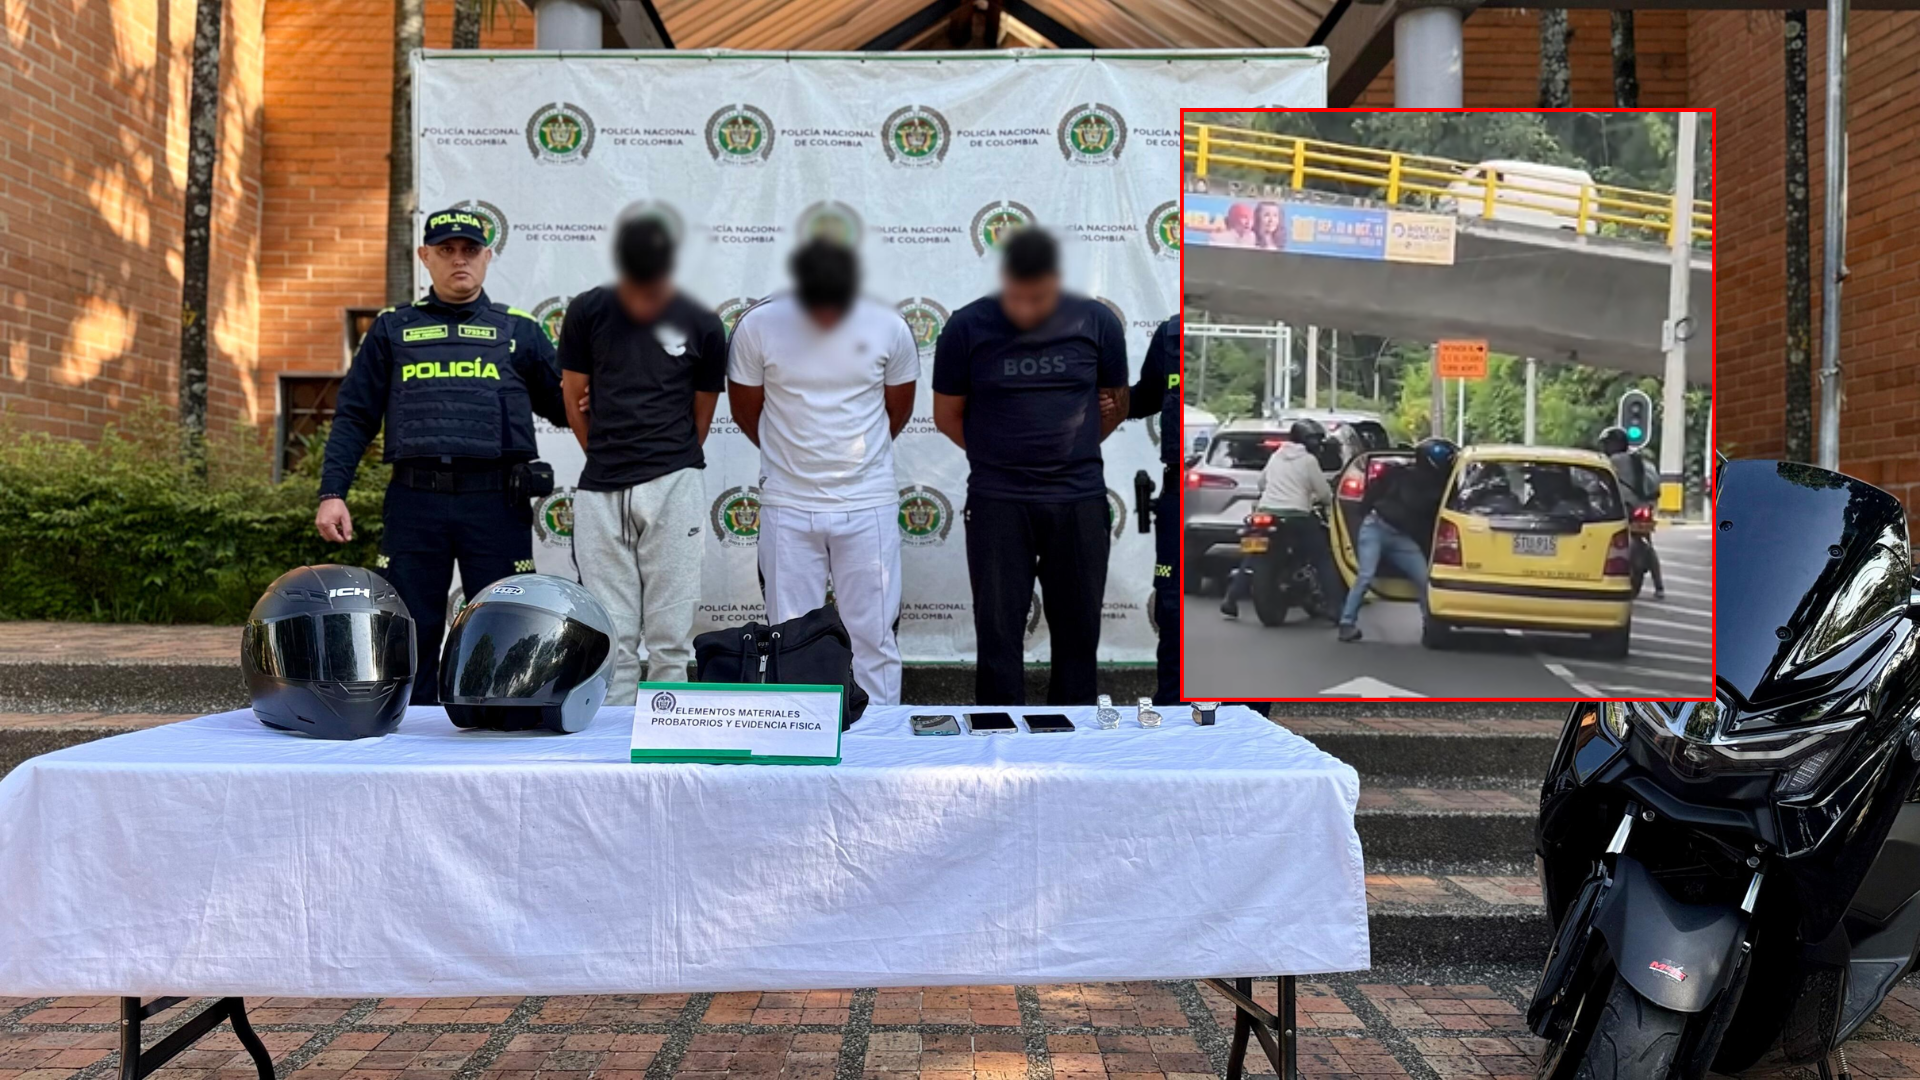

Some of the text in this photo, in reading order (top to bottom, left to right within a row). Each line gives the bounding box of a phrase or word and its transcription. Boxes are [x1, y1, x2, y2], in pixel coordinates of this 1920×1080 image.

[423, 126, 520, 136] POLICÍA NACIONAL
[600, 126, 697, 136] POLICÍA NACIONAL
[780, 127, 876, 138] POLICÍA NACIONAL
[956, 127, 1052, 137] POLICÍA NACIONAL
[1133, 127, 1171, 137] POLICÍA
[437, 138, 508, 146] DE COLOMBIA
[613, 138, 684, 146] DE COLOMBIA
[794, 138, 863, 147] DE COLOMBIA
[970, 138, 1039, 147] DE COLOMBIA
[1145, 138, 1159, 146] DE
[430, 212, 481, 229] POLICÍA
[513, 223, 552, 232] POLICÍA
[910, 226, 963, 234] NACIONAL
[1085, 224, 1139, 232] NACIONAL
[525, 233, 596, 242] DE COLOMBIA
[721, 235, 775, 244] COLOMBIA
[898, 236, 951, 244] COLOMBIA
[1133, 320, 1163, 328] POLIC
[402, 357, 500, 382] POLICÍA
[1004, 355, 1066, 376] BOSS
[329, 587, 370, 599] ICH
[699, 602, 766, 612] POLICÍA NACI
[918, 603, 966, 611] NACIONAL
[1102, 602, 1140, 610] CIONAL
[711, 614, 769, 622] DE COLOM
[901, 613, 954, 621] COLOMBIA
[675, 707, 800, 718] ELEMENTOS MATERIALES
[651, 717, 822, 731] PROBATORIOS Y EVIDENCIA FISICA
